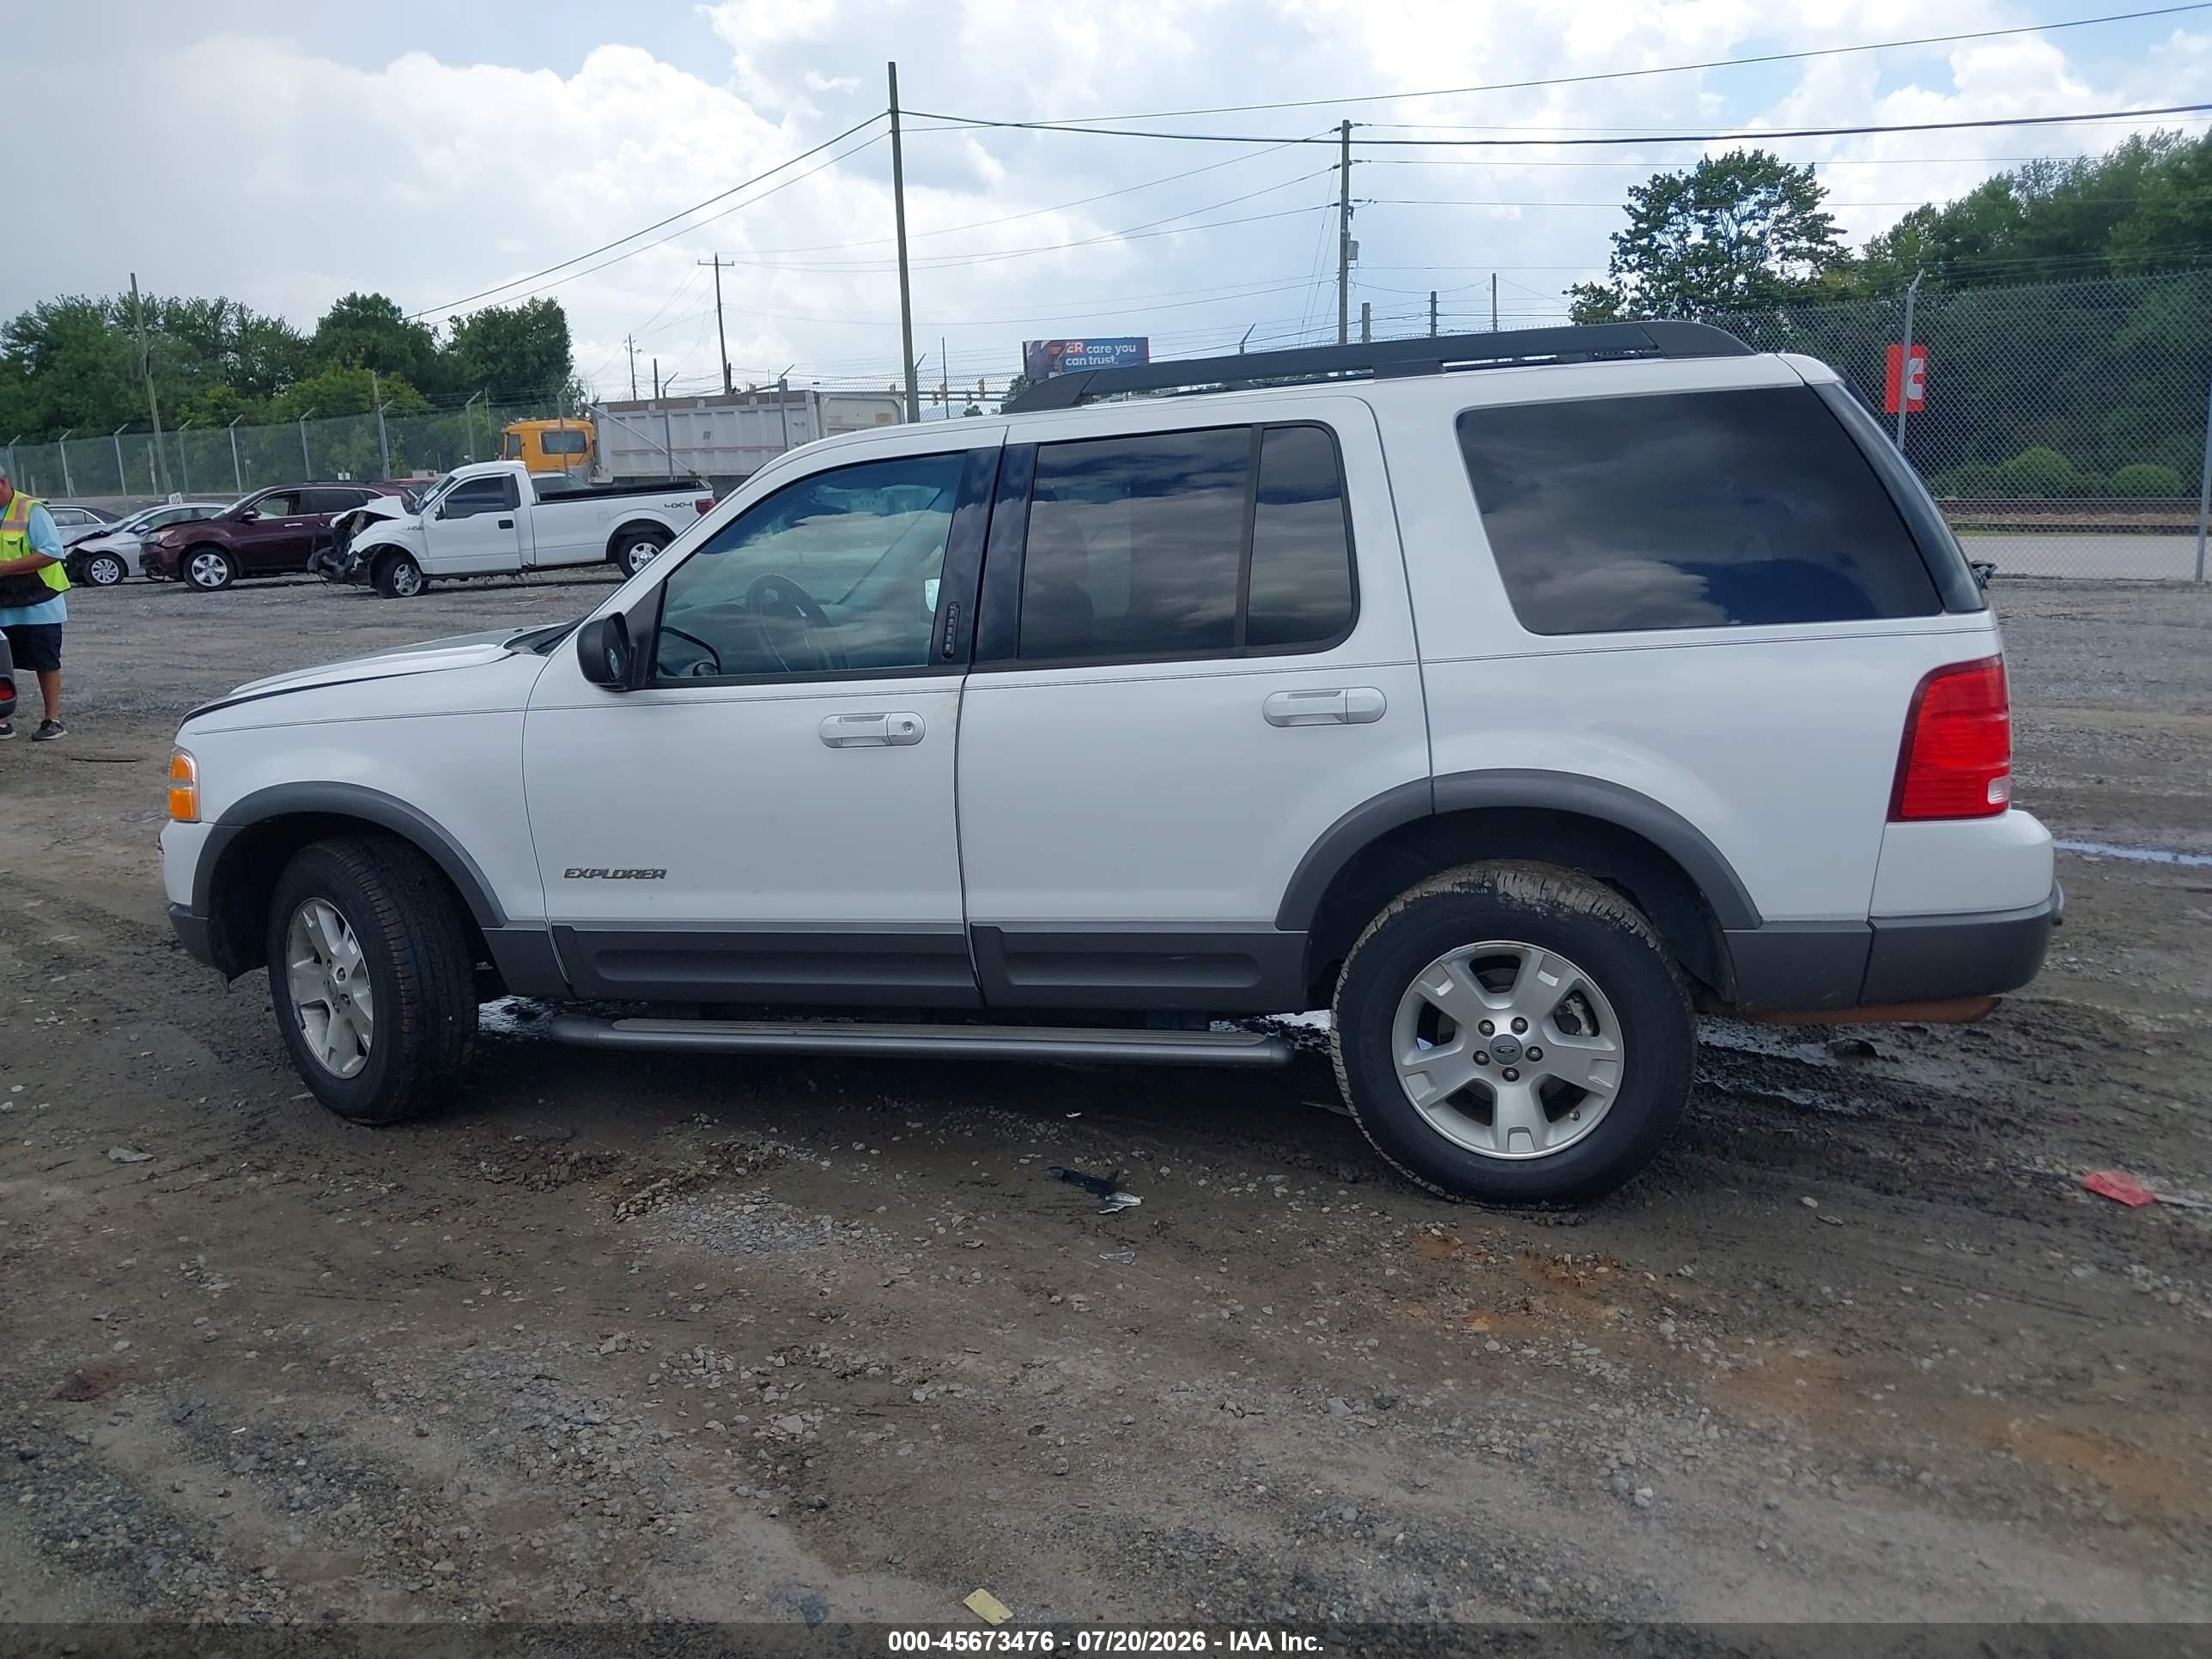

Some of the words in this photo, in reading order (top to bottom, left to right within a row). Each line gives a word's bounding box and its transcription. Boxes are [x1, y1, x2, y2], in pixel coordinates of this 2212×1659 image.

[1066, 342, 1084, 354] ER
[1086, 345, 1112, 354] care
[1115, 344, 1136, 356] you
[1066, 357, 1086, 366] can
[1089, 356, 1118, 366] trust.
[563, 868, 666, 879] EXPLORER
